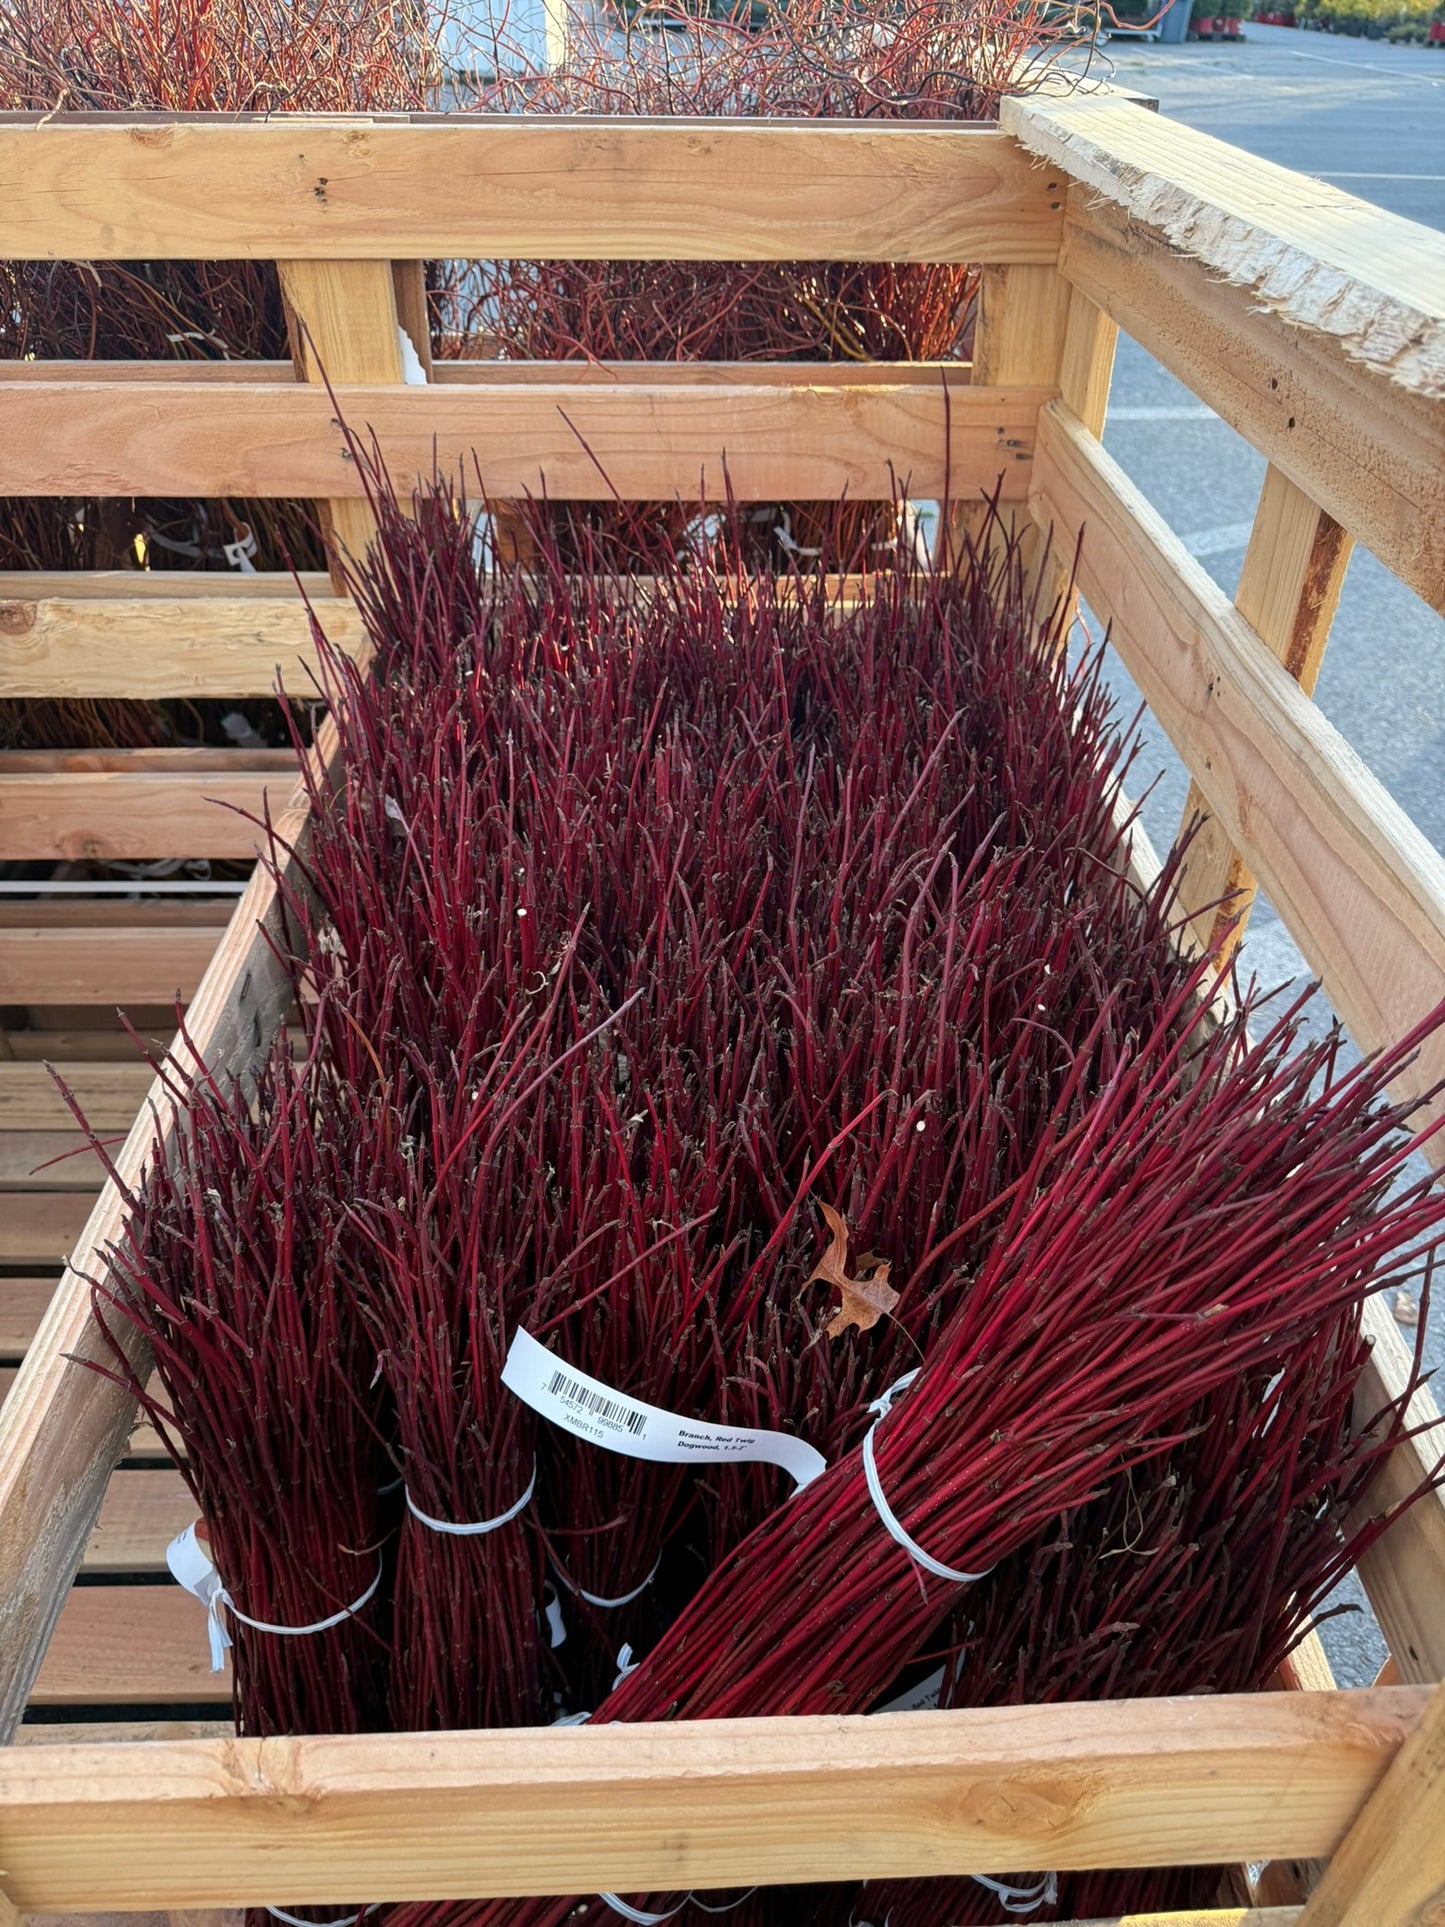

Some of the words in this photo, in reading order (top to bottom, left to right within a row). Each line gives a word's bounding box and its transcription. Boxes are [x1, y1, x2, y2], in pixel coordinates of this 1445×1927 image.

[540, 1382, 547, 1391] 7
[560, 1395, 584, 1415] 54572
[564, 1413, 605, 1439] XMBR115
[678, 1429, 713, 1442] Branch,
[715, 1435, 733, 1443] Red
[677, 1440, 720, 1451] Dogwood,
